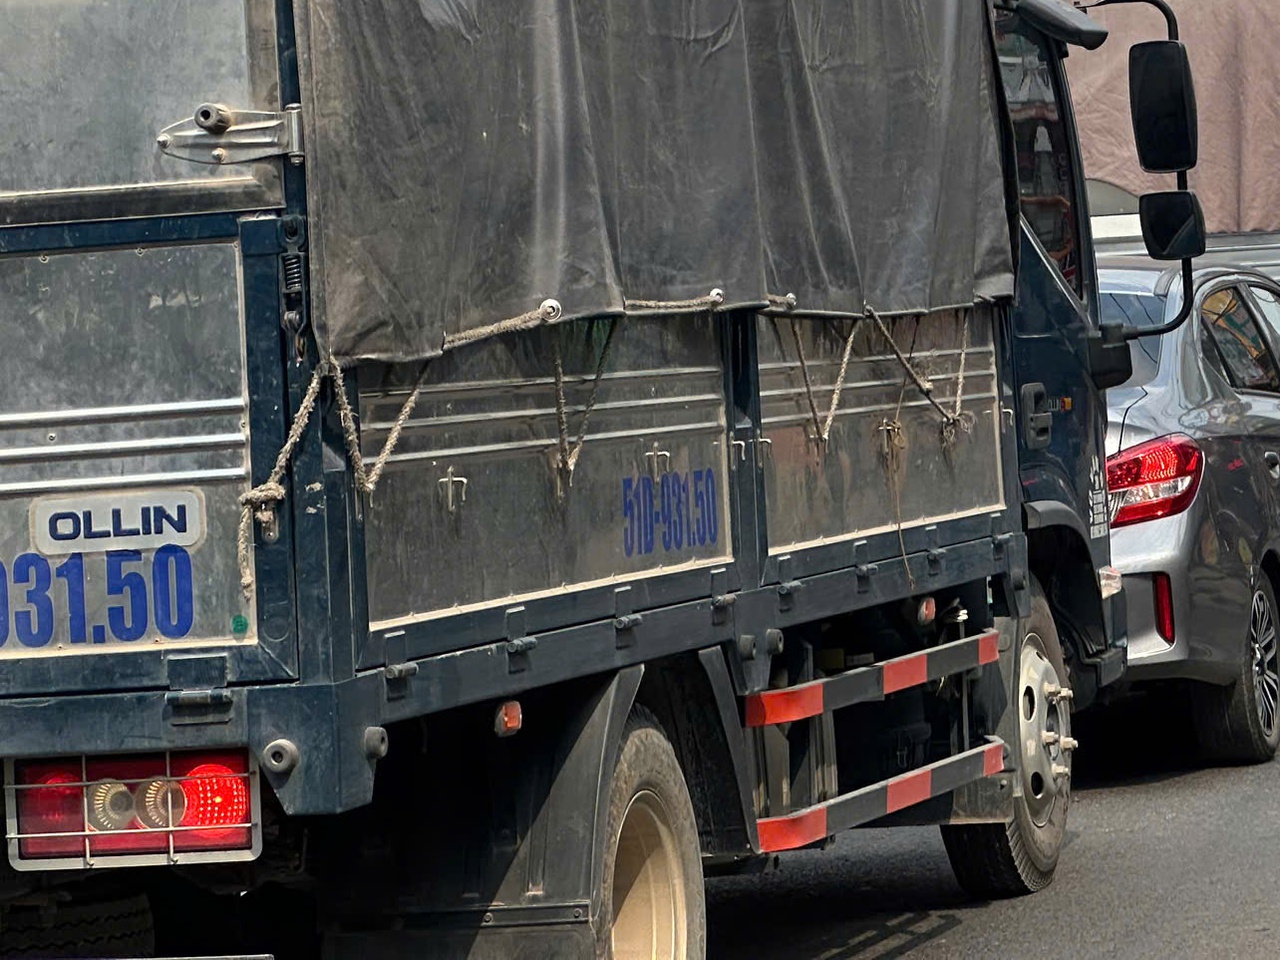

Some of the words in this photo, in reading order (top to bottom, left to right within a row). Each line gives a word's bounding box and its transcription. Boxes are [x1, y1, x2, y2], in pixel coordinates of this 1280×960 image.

[48, 504, 188, 541] OLLIN
[622, 466, 718, 558] 51D-931.50
[0, 543, 194, 648] 31.50
